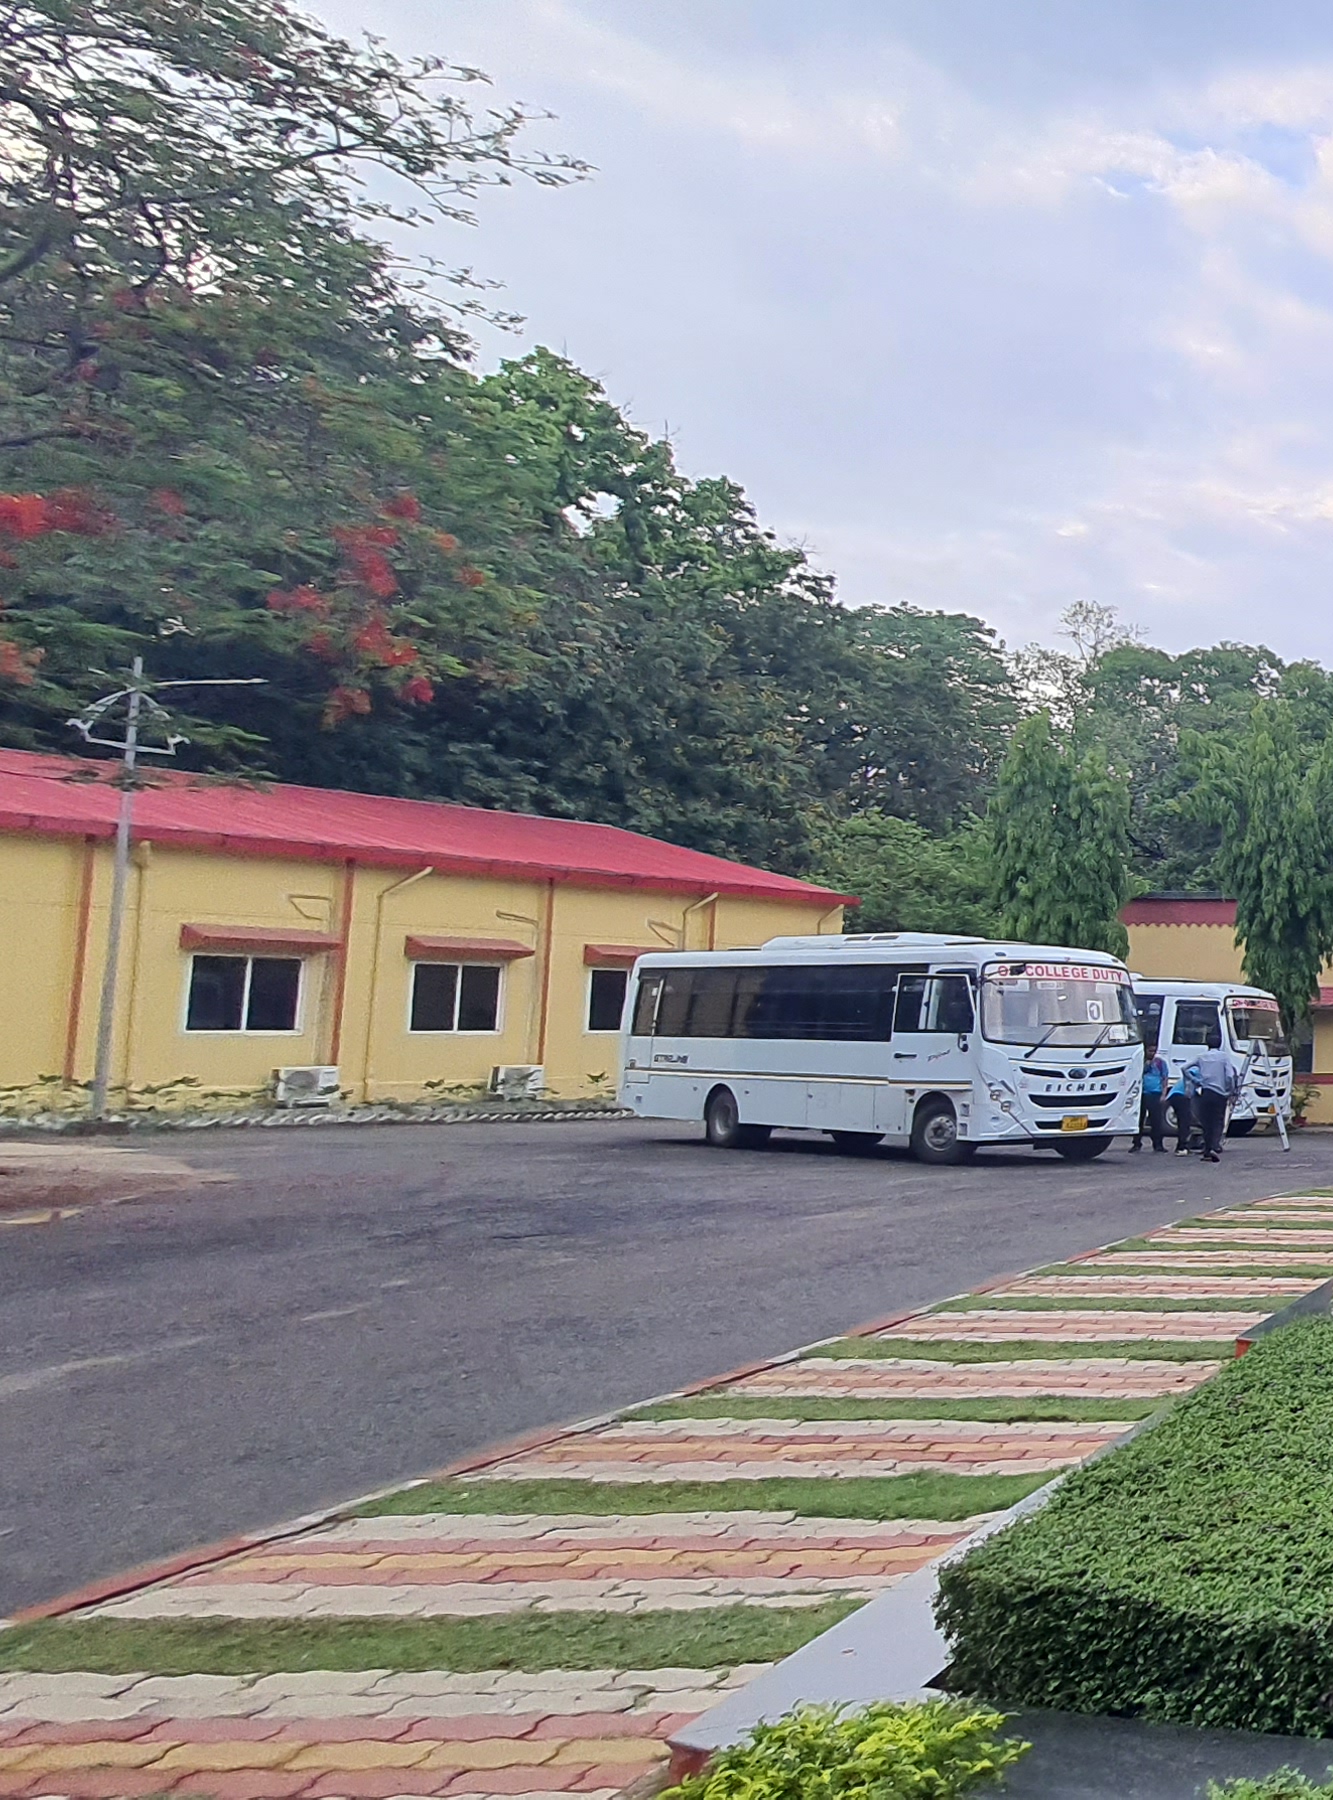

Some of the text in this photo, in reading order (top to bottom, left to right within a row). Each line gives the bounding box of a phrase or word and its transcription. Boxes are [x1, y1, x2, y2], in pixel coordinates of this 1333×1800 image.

[1025, 965, 1089, 979] COLLEGE
[1092, 970, 1123, 982] DUTY
[1045, 1083, 1108, 1092] EICHER
